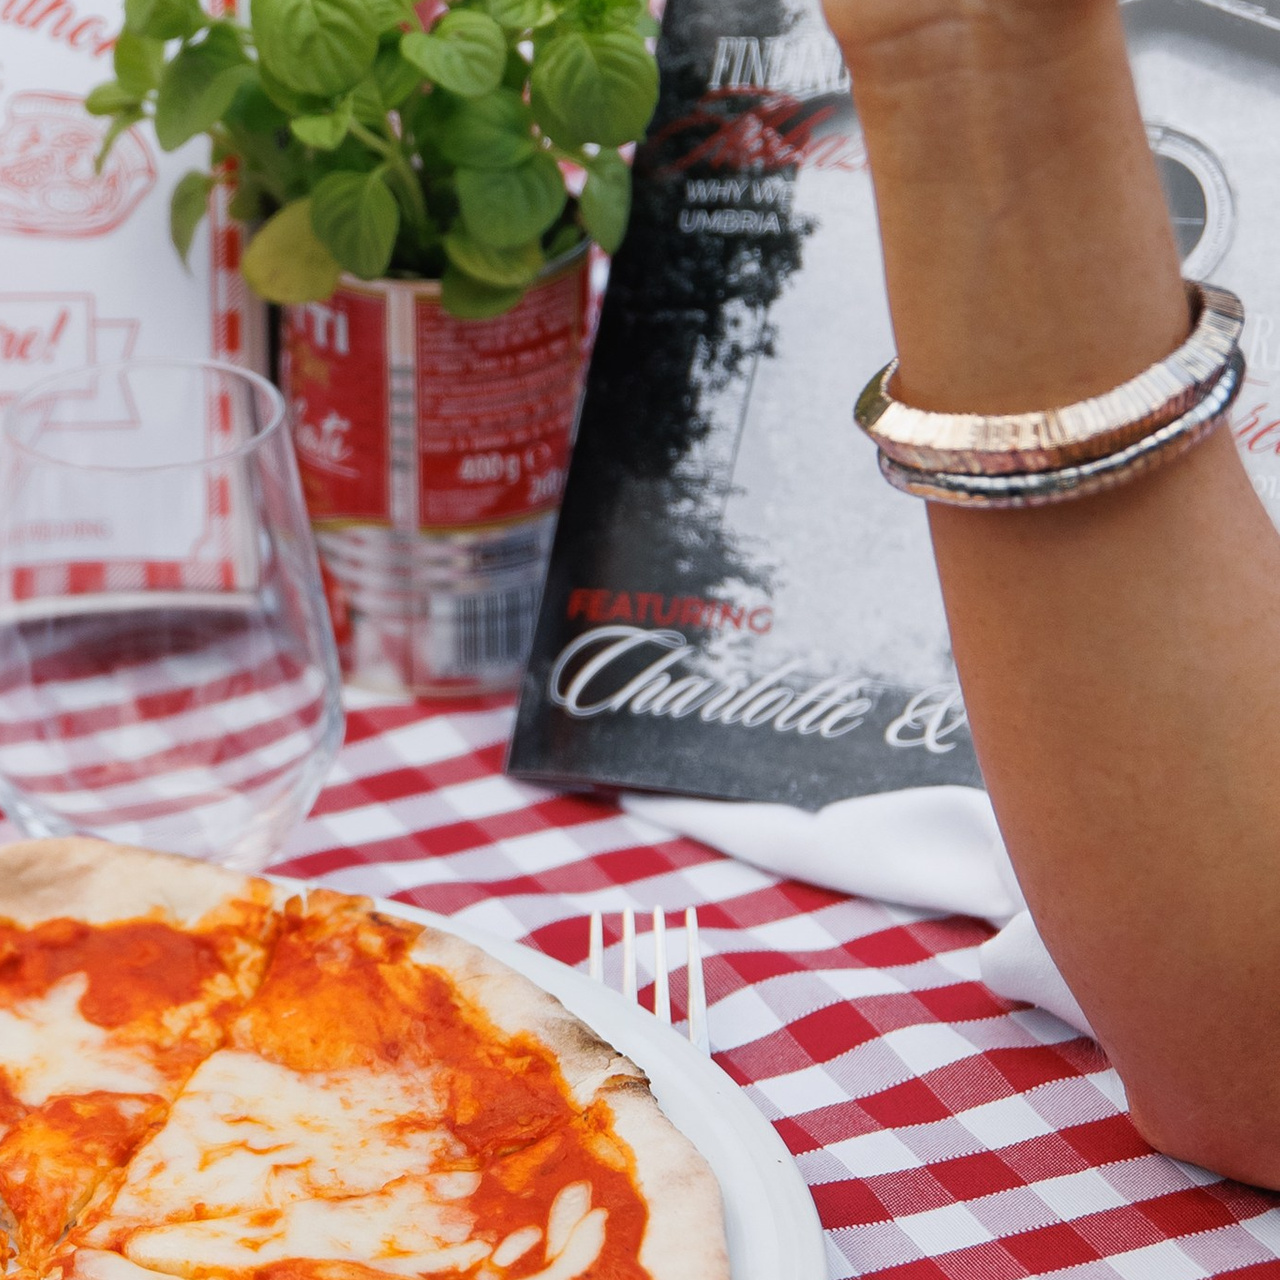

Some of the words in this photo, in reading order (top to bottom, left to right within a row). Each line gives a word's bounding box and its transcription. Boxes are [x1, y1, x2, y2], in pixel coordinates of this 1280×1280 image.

[685, 179, 748, 204] WHY
[677, 208, 782, 234] UMBRIA
[566, 587, 774, 635] FEATURING
[550, 624, 872, 739] Charlotte
